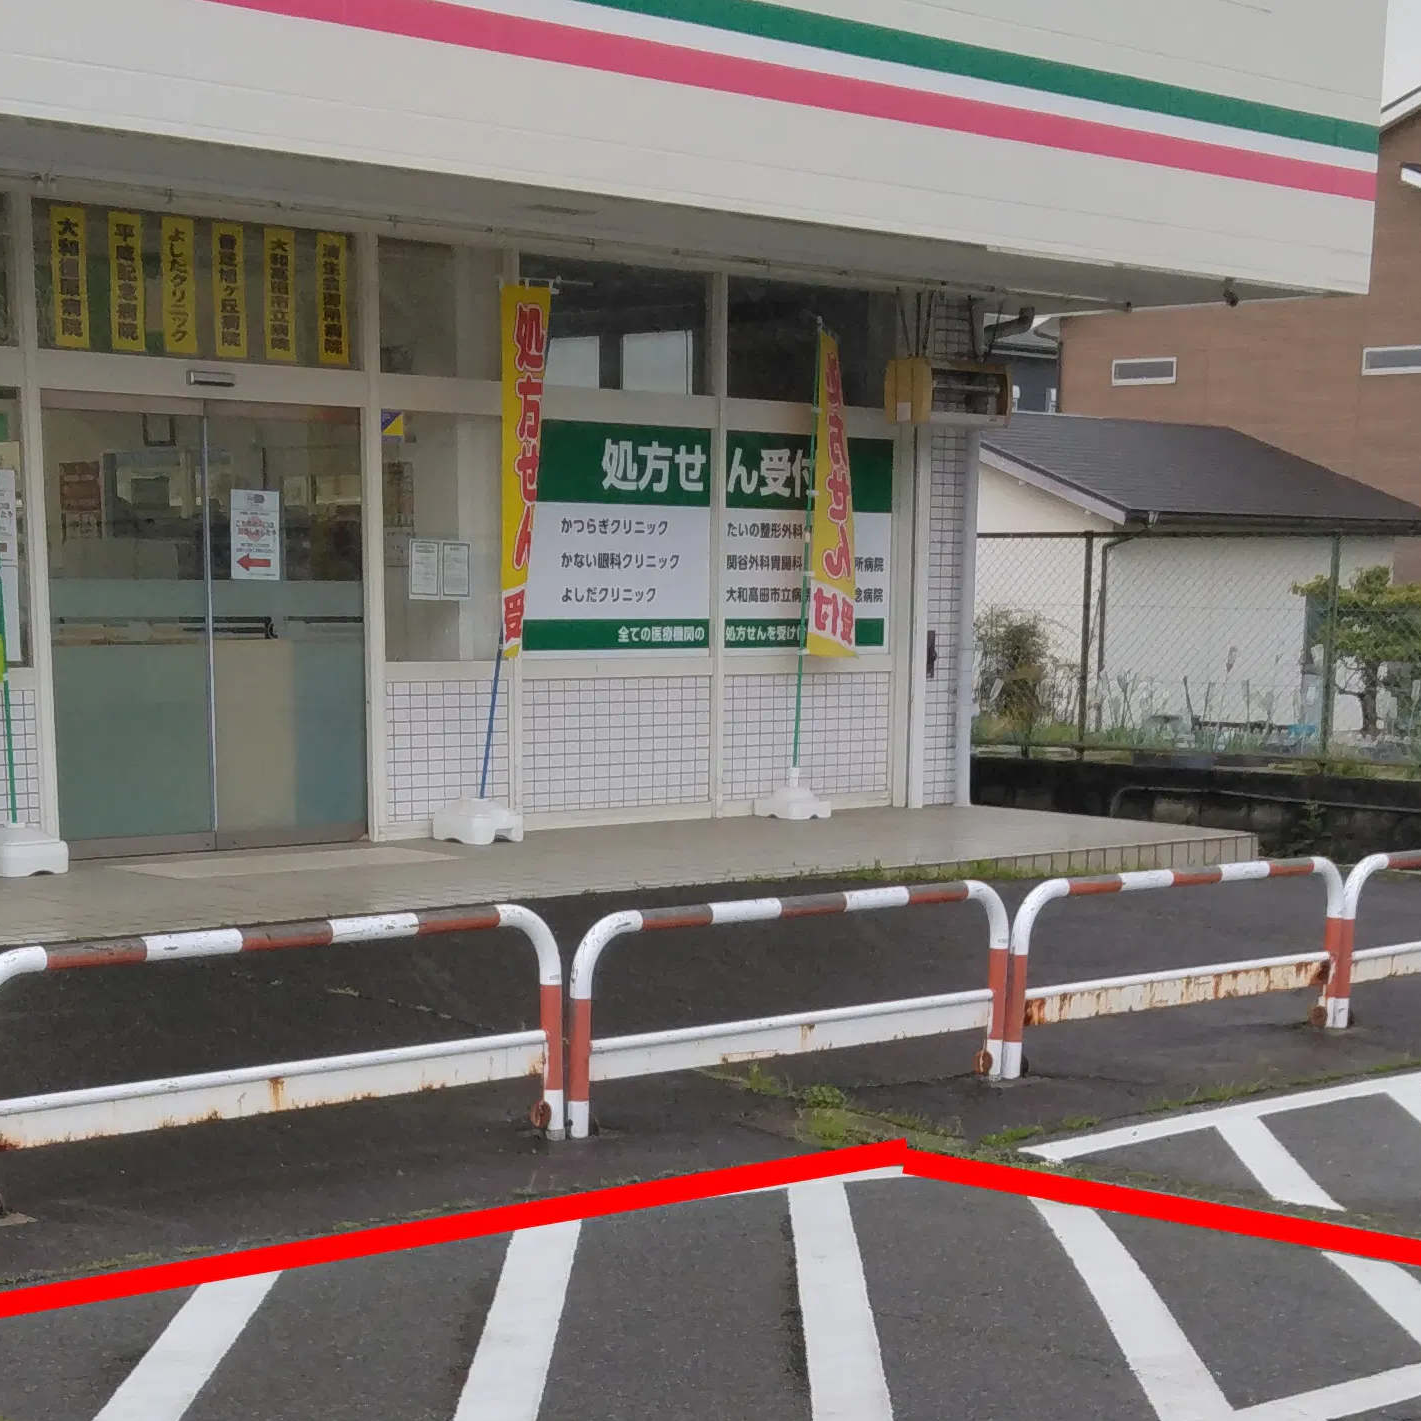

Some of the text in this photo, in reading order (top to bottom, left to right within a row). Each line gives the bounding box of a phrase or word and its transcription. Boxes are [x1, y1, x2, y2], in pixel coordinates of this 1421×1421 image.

[560, 517, 668, 536] かつらぎクリニック
[560, 552, 680, 570] かない眼科クリニック
[561, 586, 657, 603] よしだクリニック
